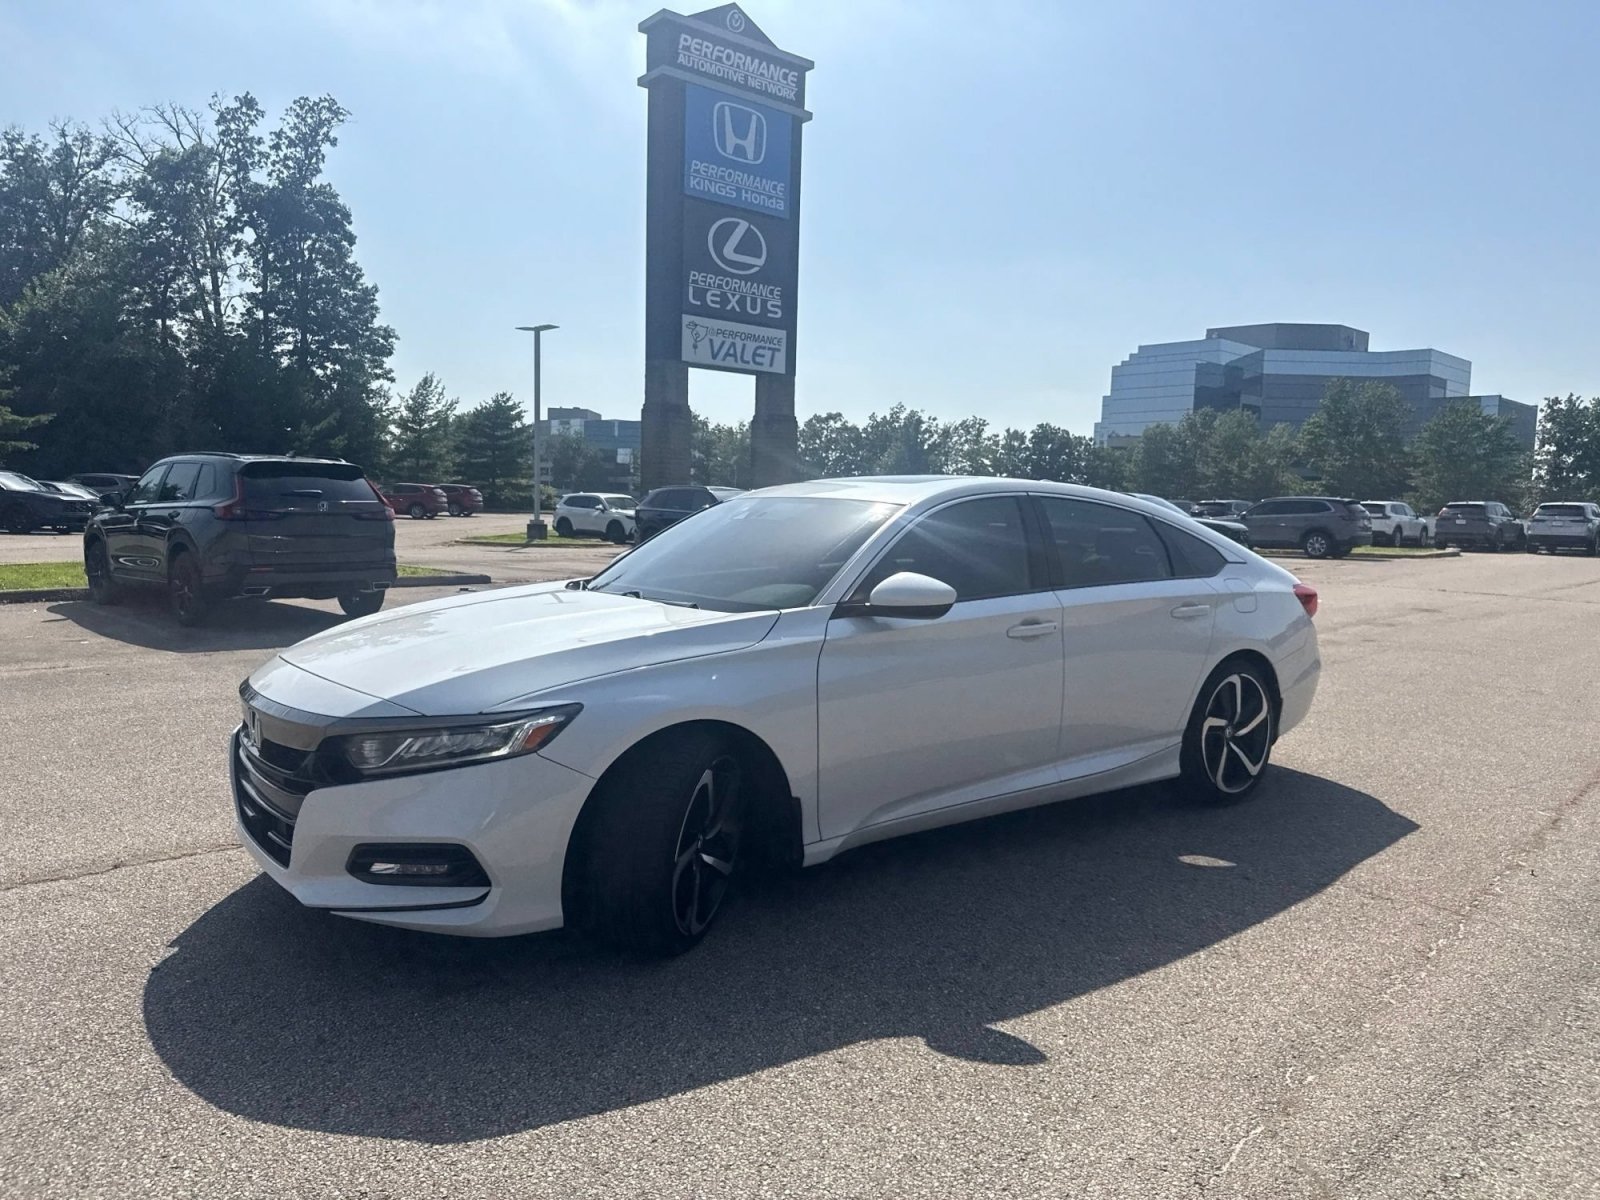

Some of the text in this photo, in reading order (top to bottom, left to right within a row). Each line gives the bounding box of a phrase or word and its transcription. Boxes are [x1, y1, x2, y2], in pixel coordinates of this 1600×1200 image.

[678, 33, 798, 87] PERFORMANCE
[677, 53, 796, 101] AUTOMOTIVE NETWORK
[690, 160, 785, 195] PERFORMANCE
[690, 177, 784, 210] KINGS Honda
[689, 271, 782, 299] PERFORMANCE
[688, 286, 782, 319] LEXUS
[709, 338, 781, 368] VALET
[716, 328, 783, 346] PERFORMANCE
